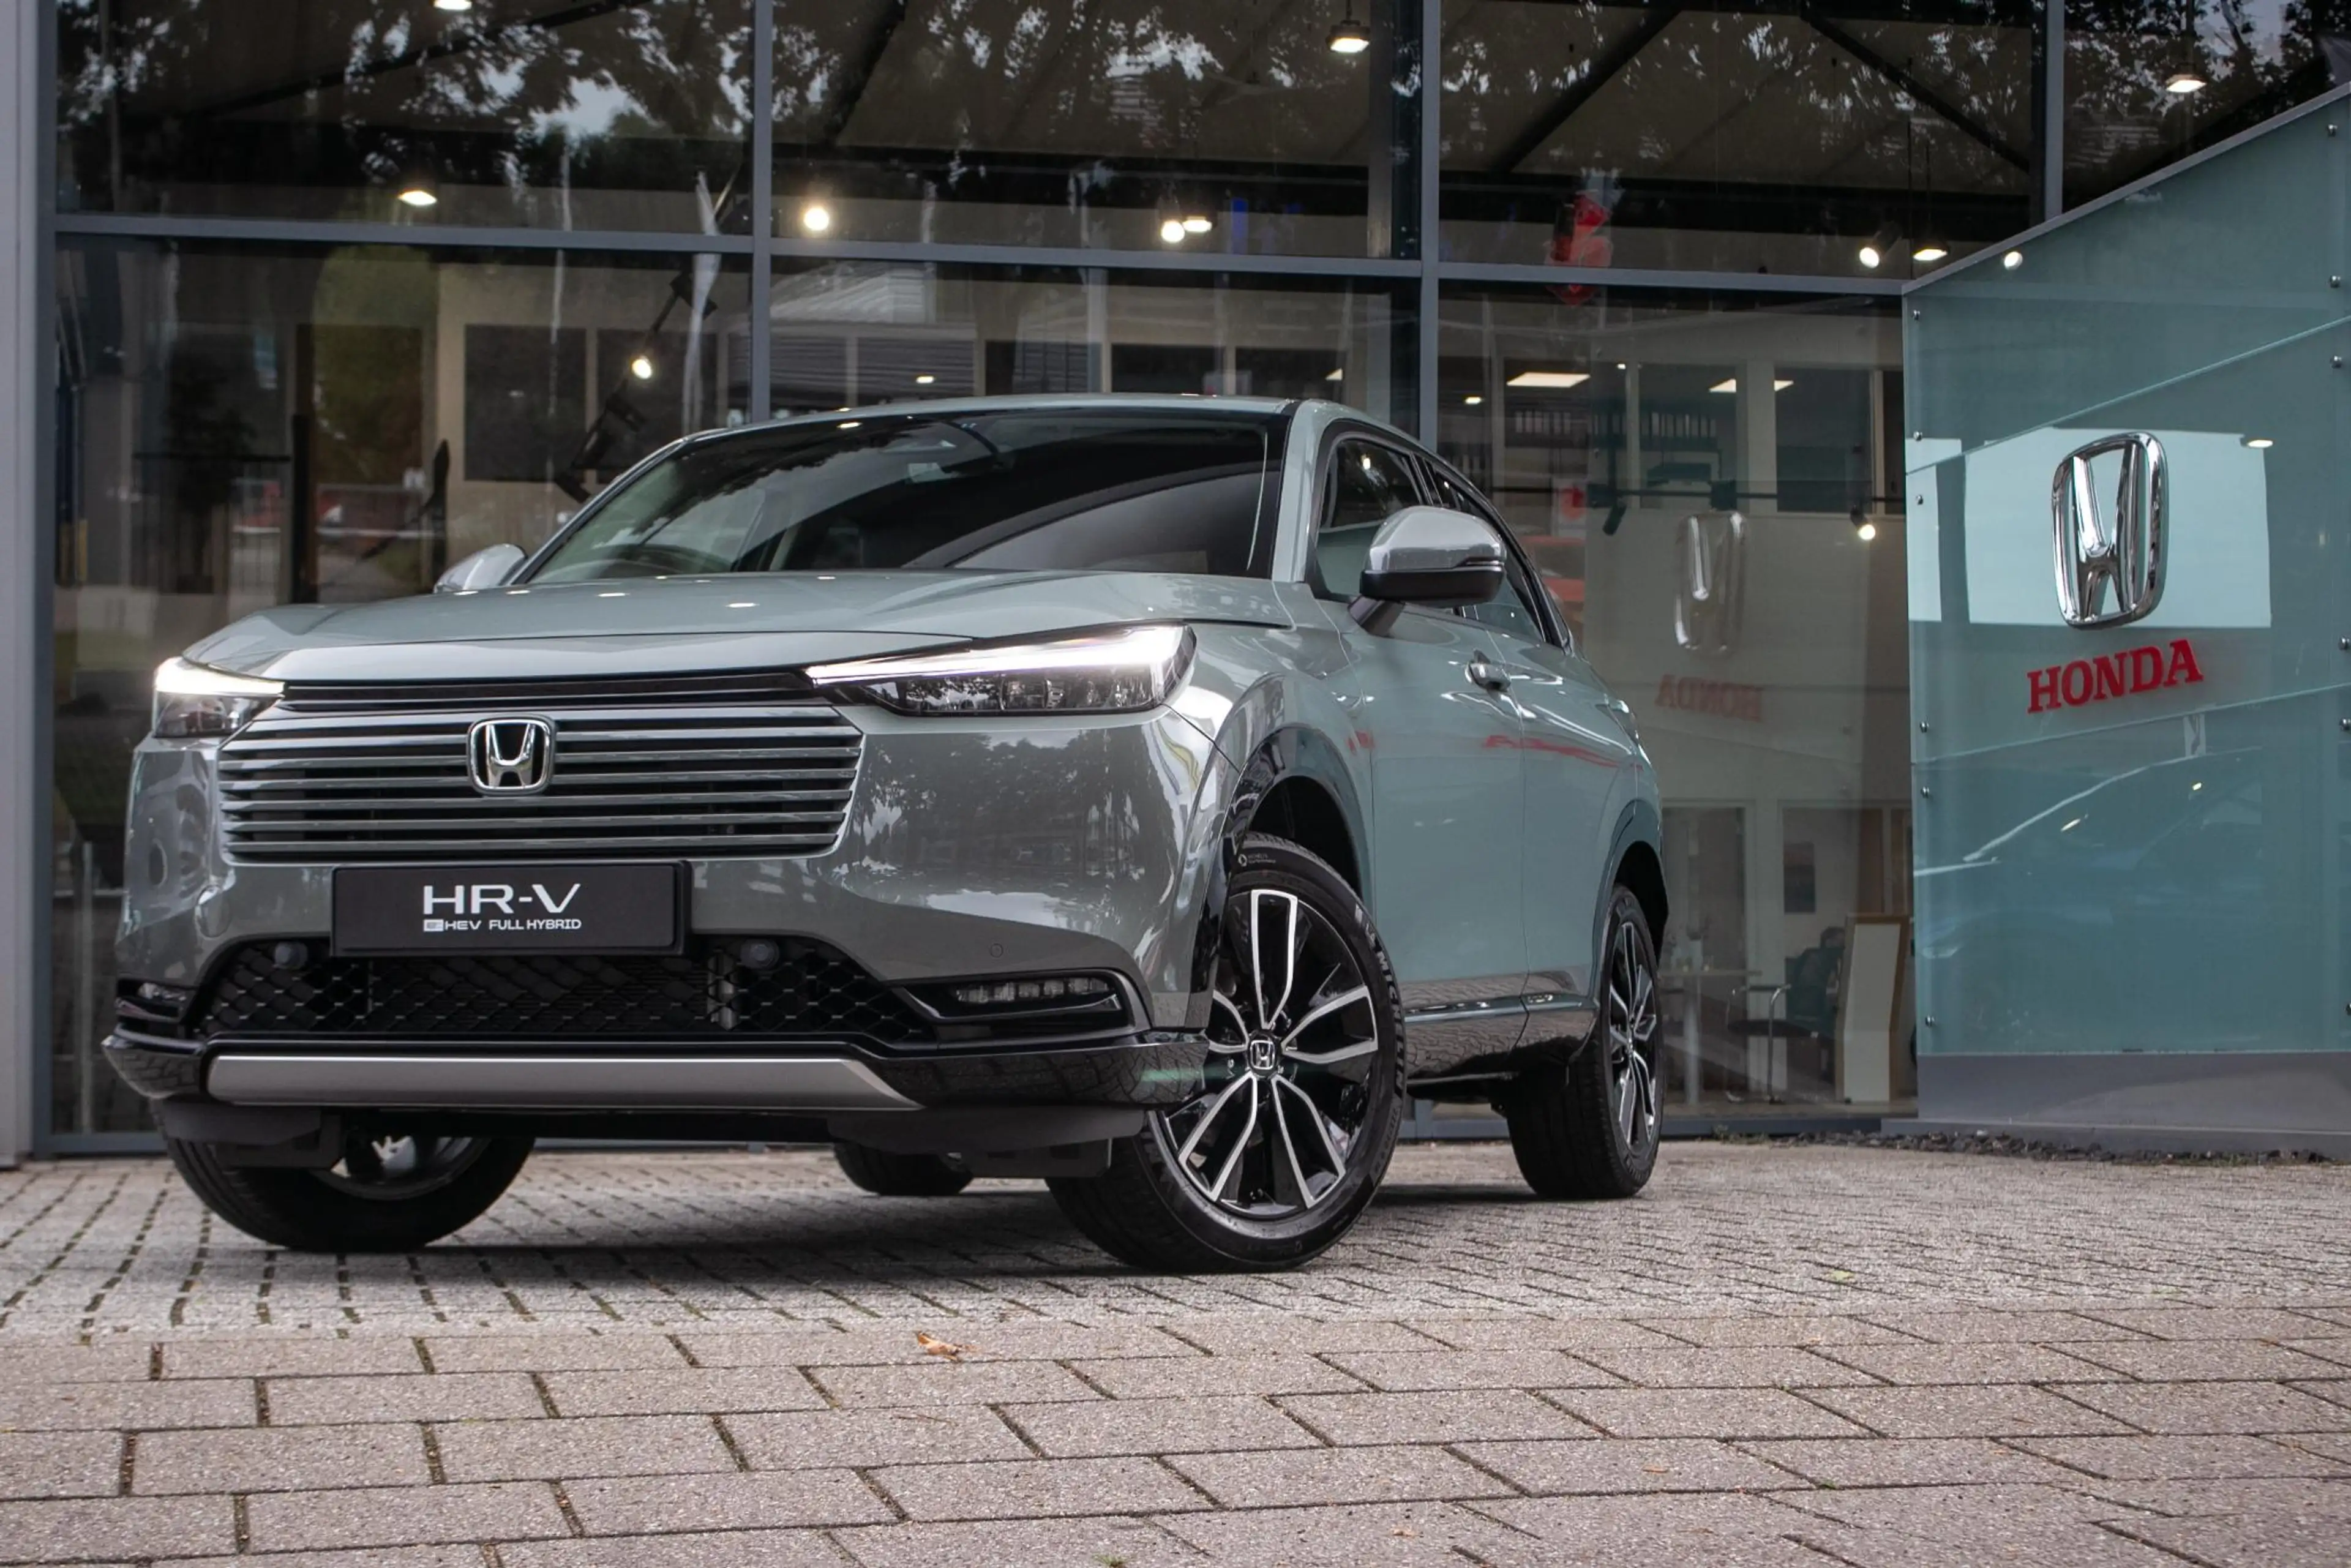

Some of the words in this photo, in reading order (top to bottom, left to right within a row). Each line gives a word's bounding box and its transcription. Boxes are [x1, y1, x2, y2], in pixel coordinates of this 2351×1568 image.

[2027, 638, 2204, 714] HONDA
[423, 883, 581, 915] HR-V
[489, 919, 525, 931] FULL
[526, 918, 582, 931] HYBRID
[1376, 951, 1404, 1090] MICHELIN
